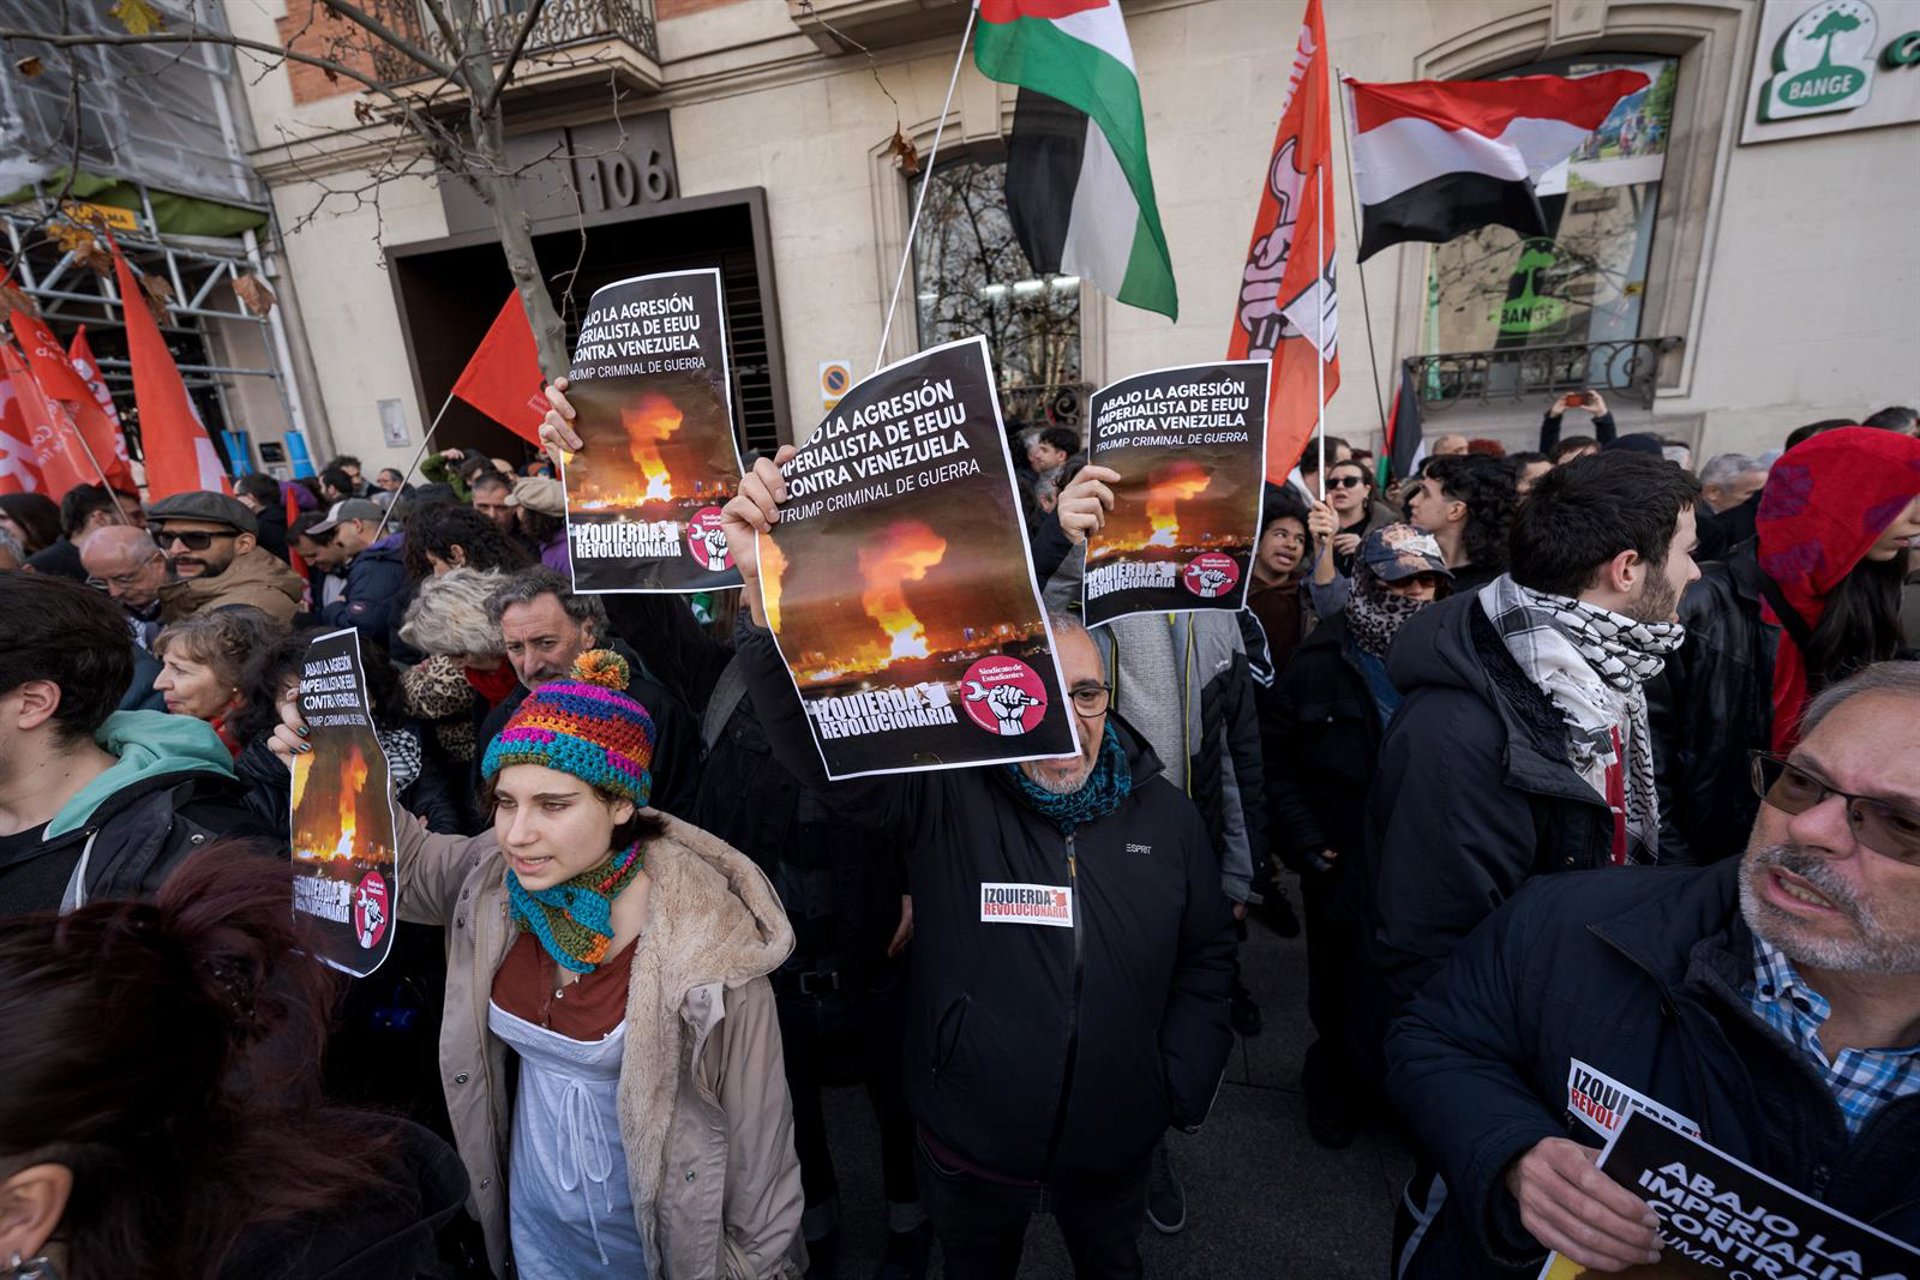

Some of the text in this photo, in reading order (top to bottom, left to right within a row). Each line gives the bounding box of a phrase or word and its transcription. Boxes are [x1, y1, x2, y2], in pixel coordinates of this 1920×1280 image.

[1788, 74, 1853, 100] BANGE
[587, 149, 670, 212] 106
[603, 306, 619, 323] LA
[620, 292, 694, 319] AGRESIÓN
[643, 318, 661, 336] DE
[664, 314, 700, 333] EEUU
[618, 334, 700, 356] VENEZUELA
[569, 356, 706, 381] RUMP CRIMINAL DE GUERRA
[826, 415, 850, 440] LA
[851, 379, 956, 431] AGRESIÓN
[1100, 378, 1245, 415] ABAJO LA AGRESIÓN
[884, 423, 912, 446] DE
[912, 402, 967, 437] EEUU
[1097, 397, 1249, 428] IMPERIALISTA DE EEUU
[1099, 413, 1246, 438] CONTRA VENEZUELA
[852, 430, 971, 479] VENEZUELA
[1096, 431, 1249, 453] TRUMP CRIMINAL DE GUERRA
[779, 458, 982, 525] TRUMP CRIMINAL DE GUERRA
[576, 522, 659, 544] IZQUIERDA
[576, 541, 683, 559] REVOLUCIONARIA
[1087, 562, 1157, 590] IZQUIERDA
[1088, 575, 1176, 601] REVOLUCIONARIA
[813, 687, 923, 722] IZQUIERDA
[819, 706, 959, 740] REVOLUCIONARIA
[1126, 843, 1152, 855] ESPRIT
[984, 888, 1051, 905] IZQUIERDA
[984, 903, 1069, 919] REVOLUCIONARIA
[1658, 1161, 1863, 1275] ABAJO LA
